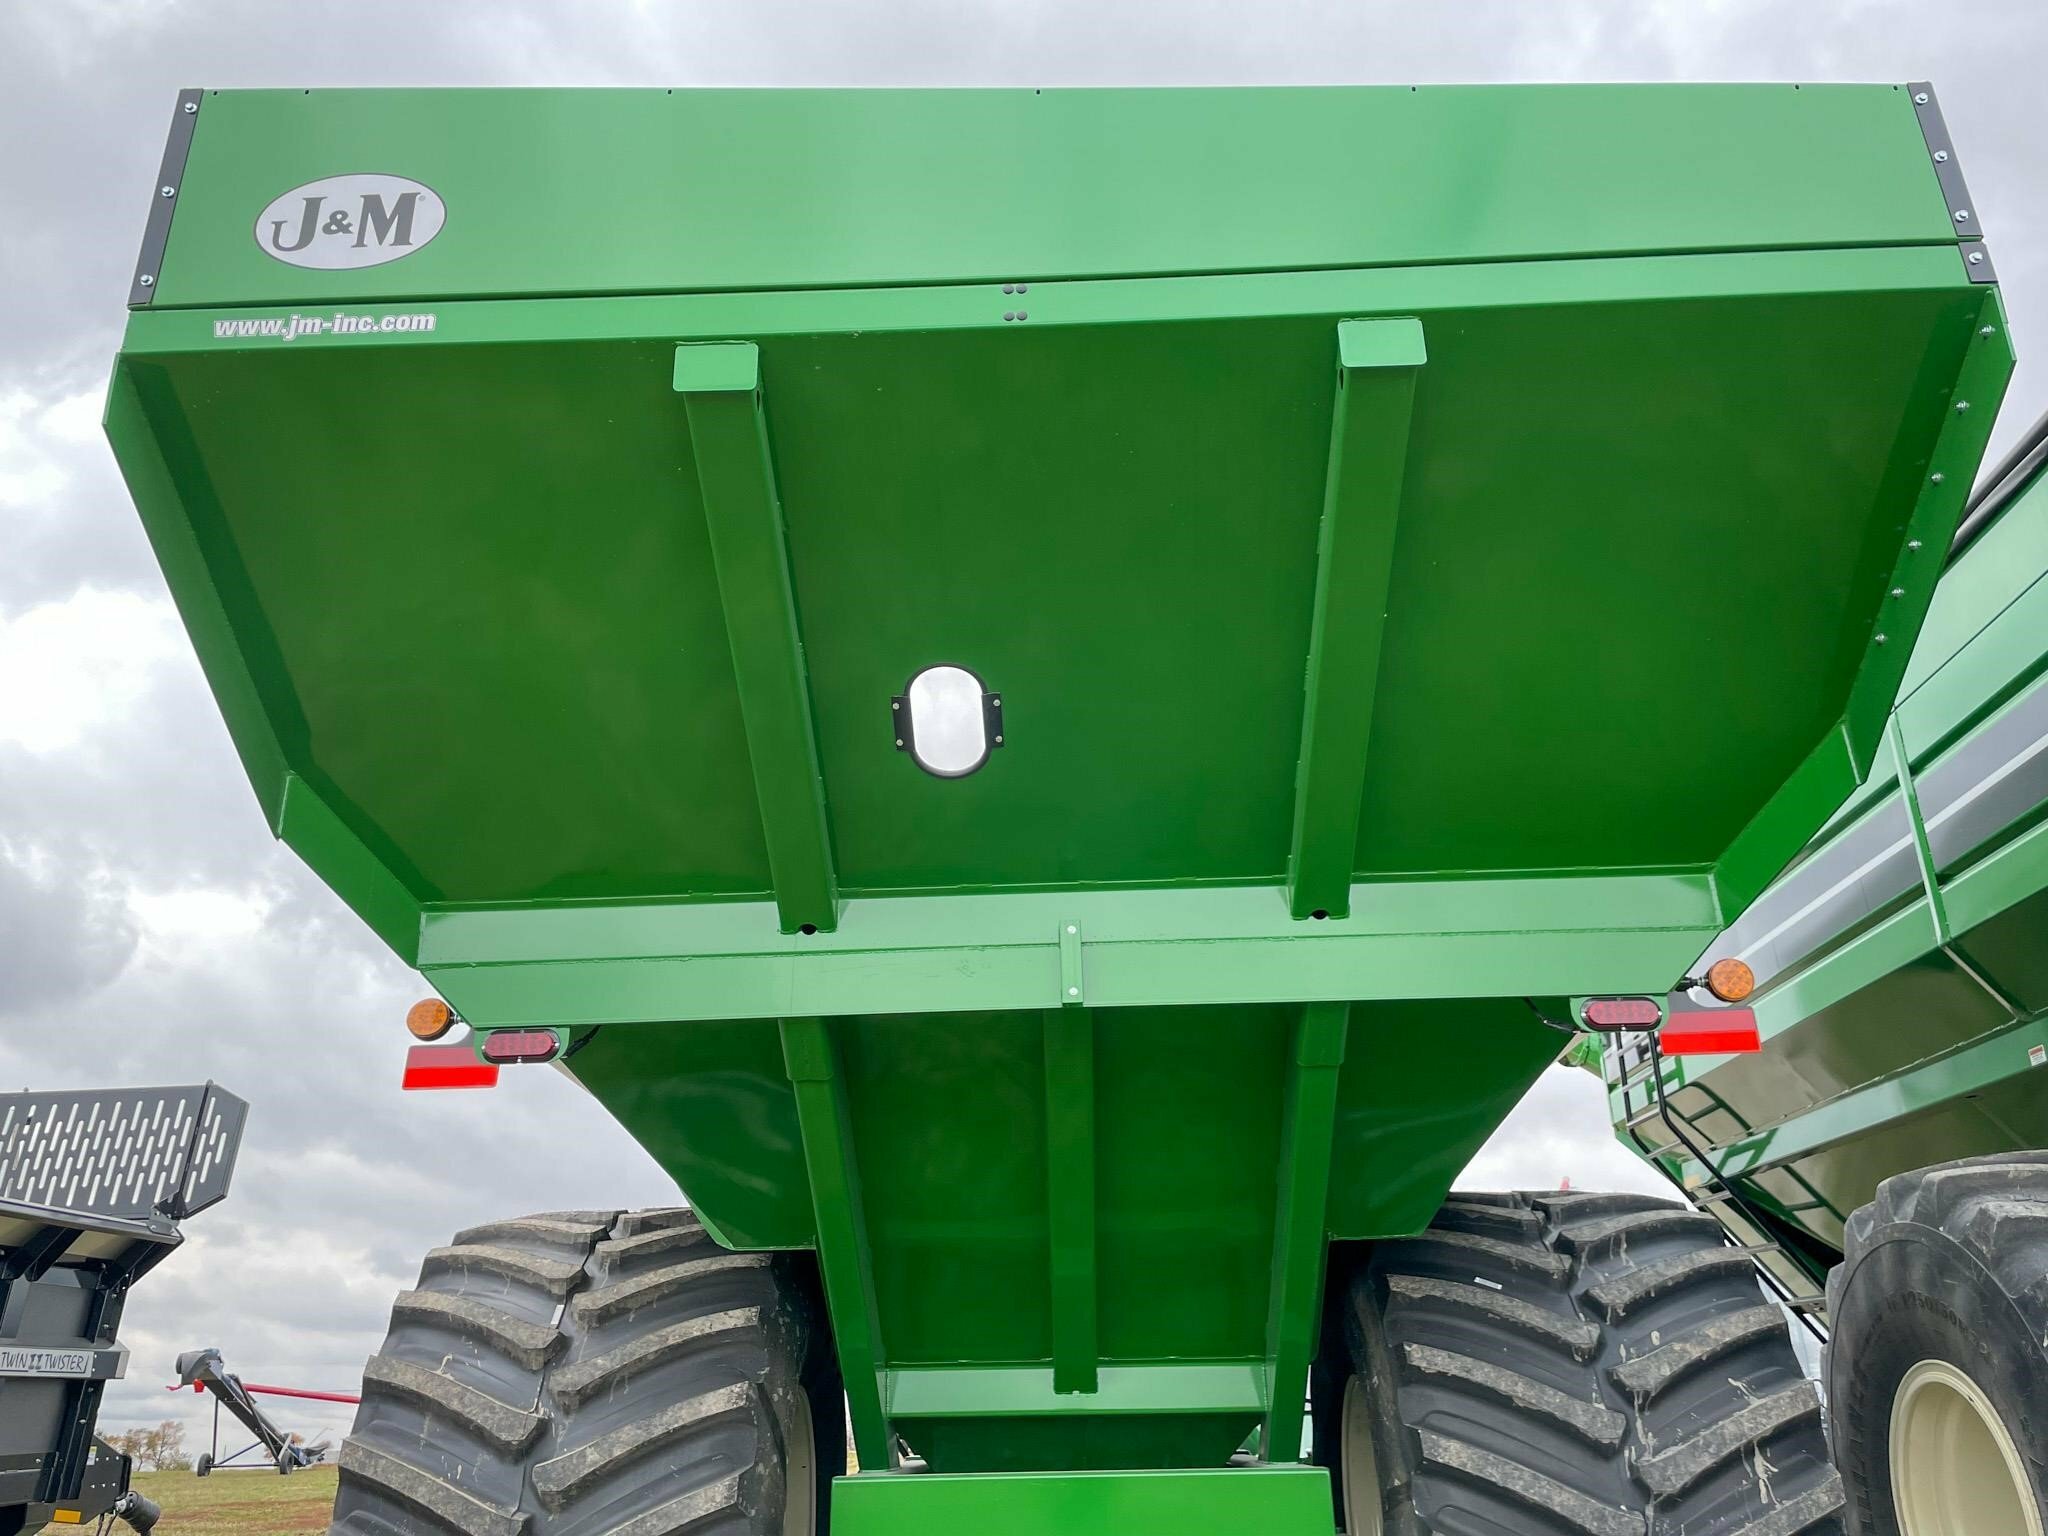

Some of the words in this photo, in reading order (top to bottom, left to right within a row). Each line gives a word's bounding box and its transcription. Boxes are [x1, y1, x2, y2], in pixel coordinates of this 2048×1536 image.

[271, 192, 421, 252] J&M
[214, 313, 436, 341] www.jm-inc.com
[1, 1351, 28, 1368] TWIN
[44, 1353, 85, 1371] TWISTER
